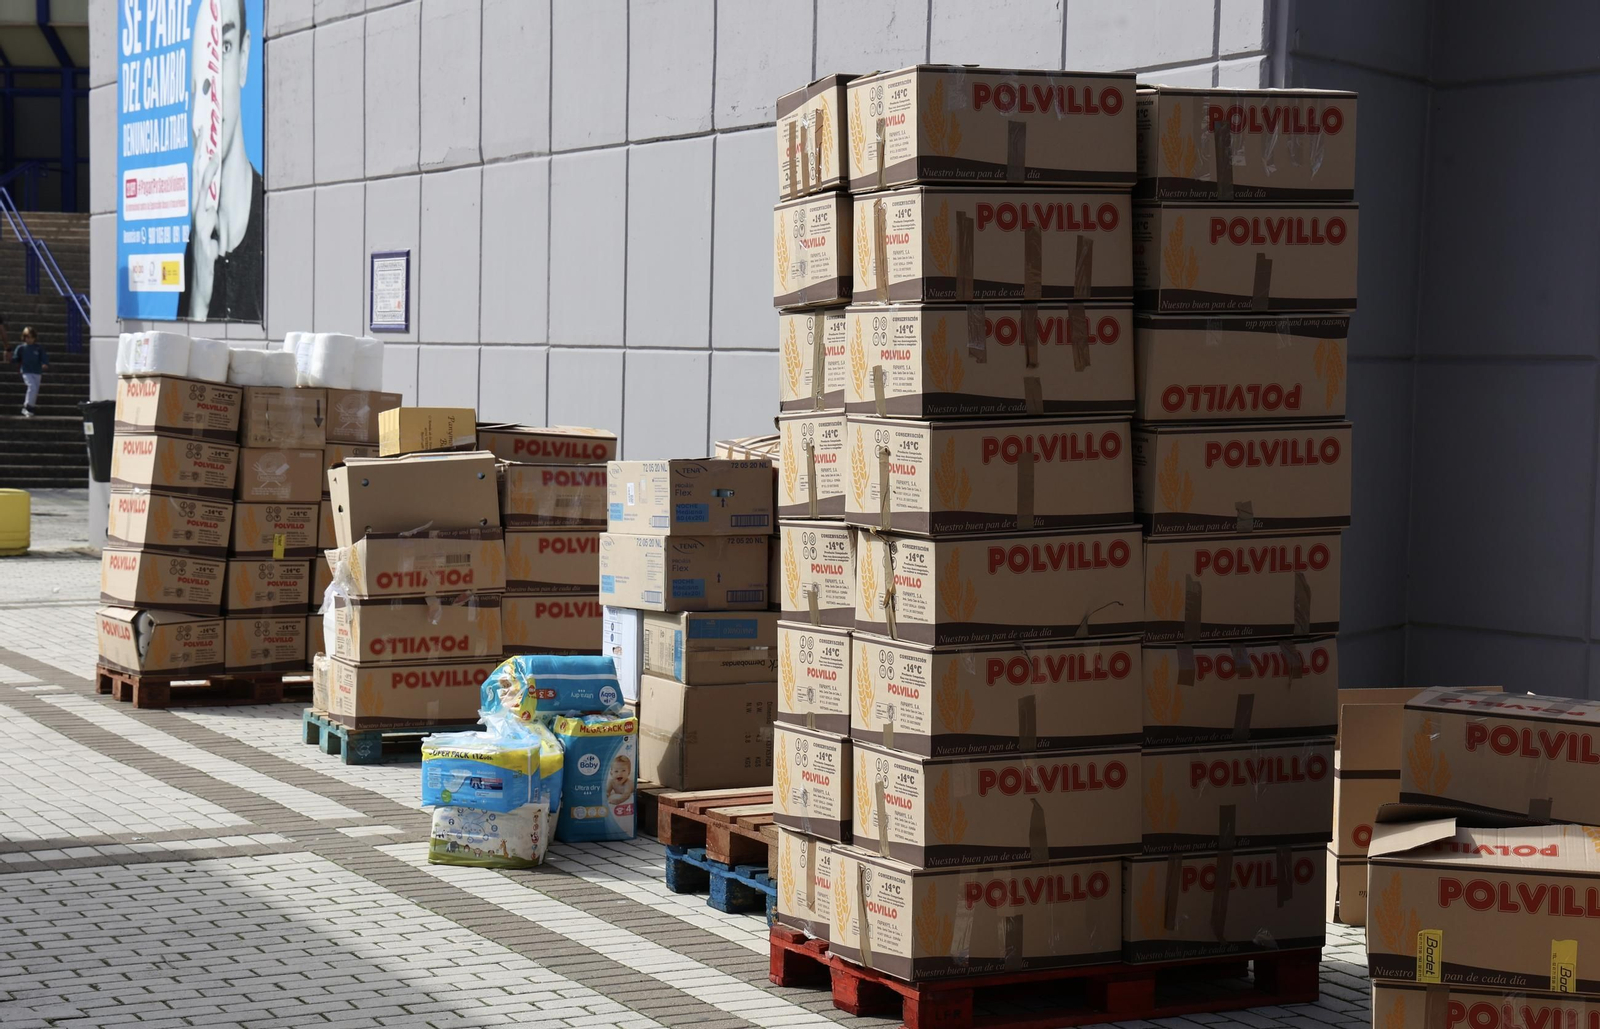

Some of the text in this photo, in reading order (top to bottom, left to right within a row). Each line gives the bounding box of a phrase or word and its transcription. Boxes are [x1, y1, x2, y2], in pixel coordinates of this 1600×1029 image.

[122, 48, 189, 114] DEL CAMBIO,
[972, 81, 1124, 116] POLVILLO
[1207, 104, 1344, 136] POLVILLO
[123, 118, 160, 157] DENUNCIA
[922, 168, 954, 177] Nuestro
[956, 168, 975, 178] buen
[977, 171, 993, 180] pan
[995, 169, 1004, 178] de
[1159, 189, 1253, 198] Nuestro buen cada
[976, 202, 1120, 232] POLVILLO
[1209, 216, 1347, 246] POLVILLO
[1162, 300, 1236, 311] Nuestro buen pan de
[881, 349, 911, 361] POLVILLO
[127, 381, 157, 397] POLVILLO
[1160, 383, 1302, 413] POLVILLO
[197, 402, 229, 412] POLVILLO
[927, 404, 958, 413] Nuestro
[960, 404, 978, 412] buen
[980, 405, 995, 415] pan
[997, 403, 1006, 412] de
[123, 440, 153, 455] POLVILLO
[513, 438, 607, 461] POLVILLO
[982, 430, 1122, 465] POLVILLO
[1205, 436, 1341, 469] POLVILLO
[193, 460, 225, 470] POLVILLO
[643, 463, 648, 472] 72
[119, 498, 146, 514] POLVILLO
[186, 519, 218, 529] POLVILLO
[933, 519, 1011, 533] Nuestro buen pan de
[1156, 521, 1231, 532] Nuestro buen pan de
[109, 555, 137, 571] POLVILLO
[987, 538, 1132, 575] POLVILLO
[1194, 543, 1331, 577] POLVILLO
[811, 563, 843, 575] POLVILLO
[177, 576, 210, 586] POLVILLO
[102, 620, 131, 640] POLVILLO
[939, 629, 1039, 643] Nuestro buen pan de cada
[183, 640, 213, 648] POLVILLO
[369, 634, 470, 656] POLVILLO
[807, 667, 837, 681] POLVILLO
[985, 650, 1132, 687] POLVILLO
[391, 668, 488, 690] POLVILLO
[887, 682, 920, 700] POLVILLO
[1438, 698, 1586, 717] POLVILLO
[452, 751, 470, 759] PACK
[936, 745, 967, 755] Nuestro
[968, 743, 988, 753] buen
[989, 744, 1004, 754] pan
[580, 761, 598, 770] Baby
[1189, 753, 1328, 789] POLVILLO
[802, 770, 830, 786] POLVILLO
[978, 759, 1128, 797] POLVILLO
[928, 851, 1031, 865] Nuestro buen pan de cada
[877, 871, 906, 884] CONSERVACIÓN
[881, 882, 901, 895] -14°C
[965, 870, 1110, 910] POLVILLO
[1426, 936, 1438, 975] Bodet
[914, 968, 945, 978] Nuestro
[1374, 966, 1527, 985] Nuestro pan de cada día
